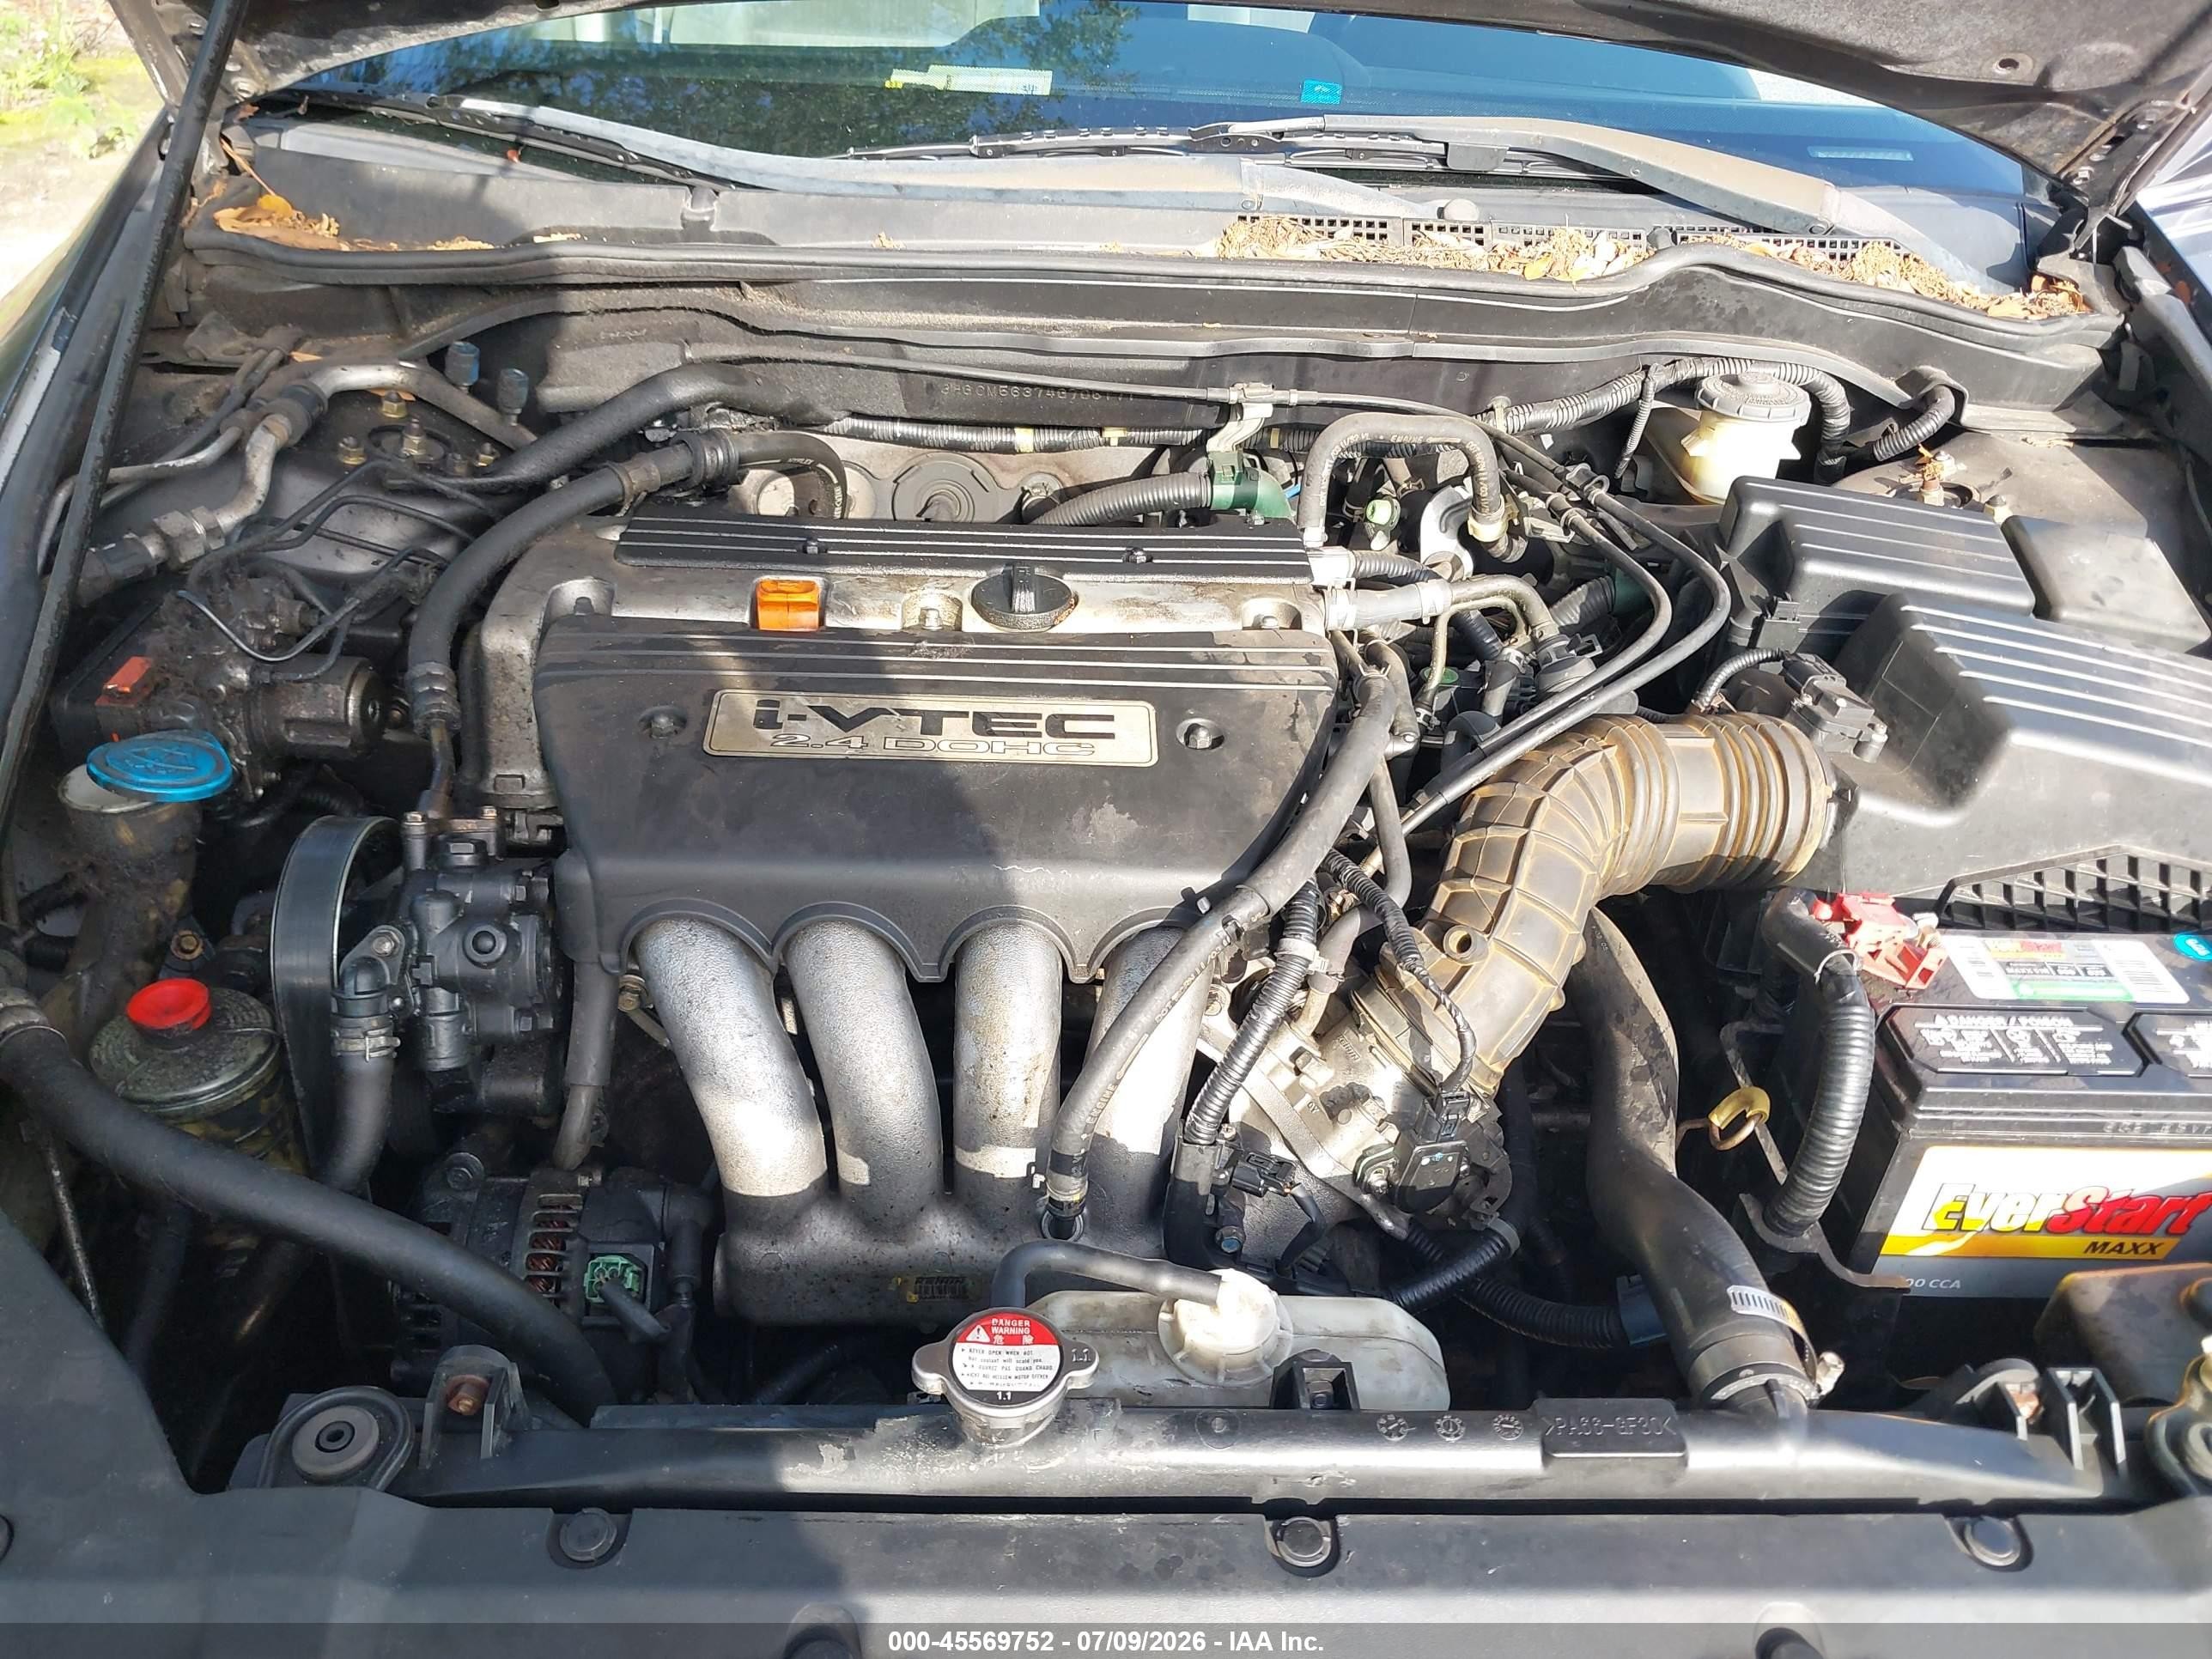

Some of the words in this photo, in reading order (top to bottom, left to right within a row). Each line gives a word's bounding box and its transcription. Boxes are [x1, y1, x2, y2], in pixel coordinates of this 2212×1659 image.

[752, 699, 1115, 739] i-VTEC
[769, 732, 868, 750] 2.4
[883, 736, 1096, 756] DOHC
[1922, 1183, 2212, 1235] EverStart
[2082, 1241, 2164, 1255] MAXX
[1929, 1279, 1961, 1289] CCA
[991, 1318, 1030, 1328] DANGER
[991, 1326, 1030, 1335] WARNING
[996, 1392, 1012, 1401] 1.1
